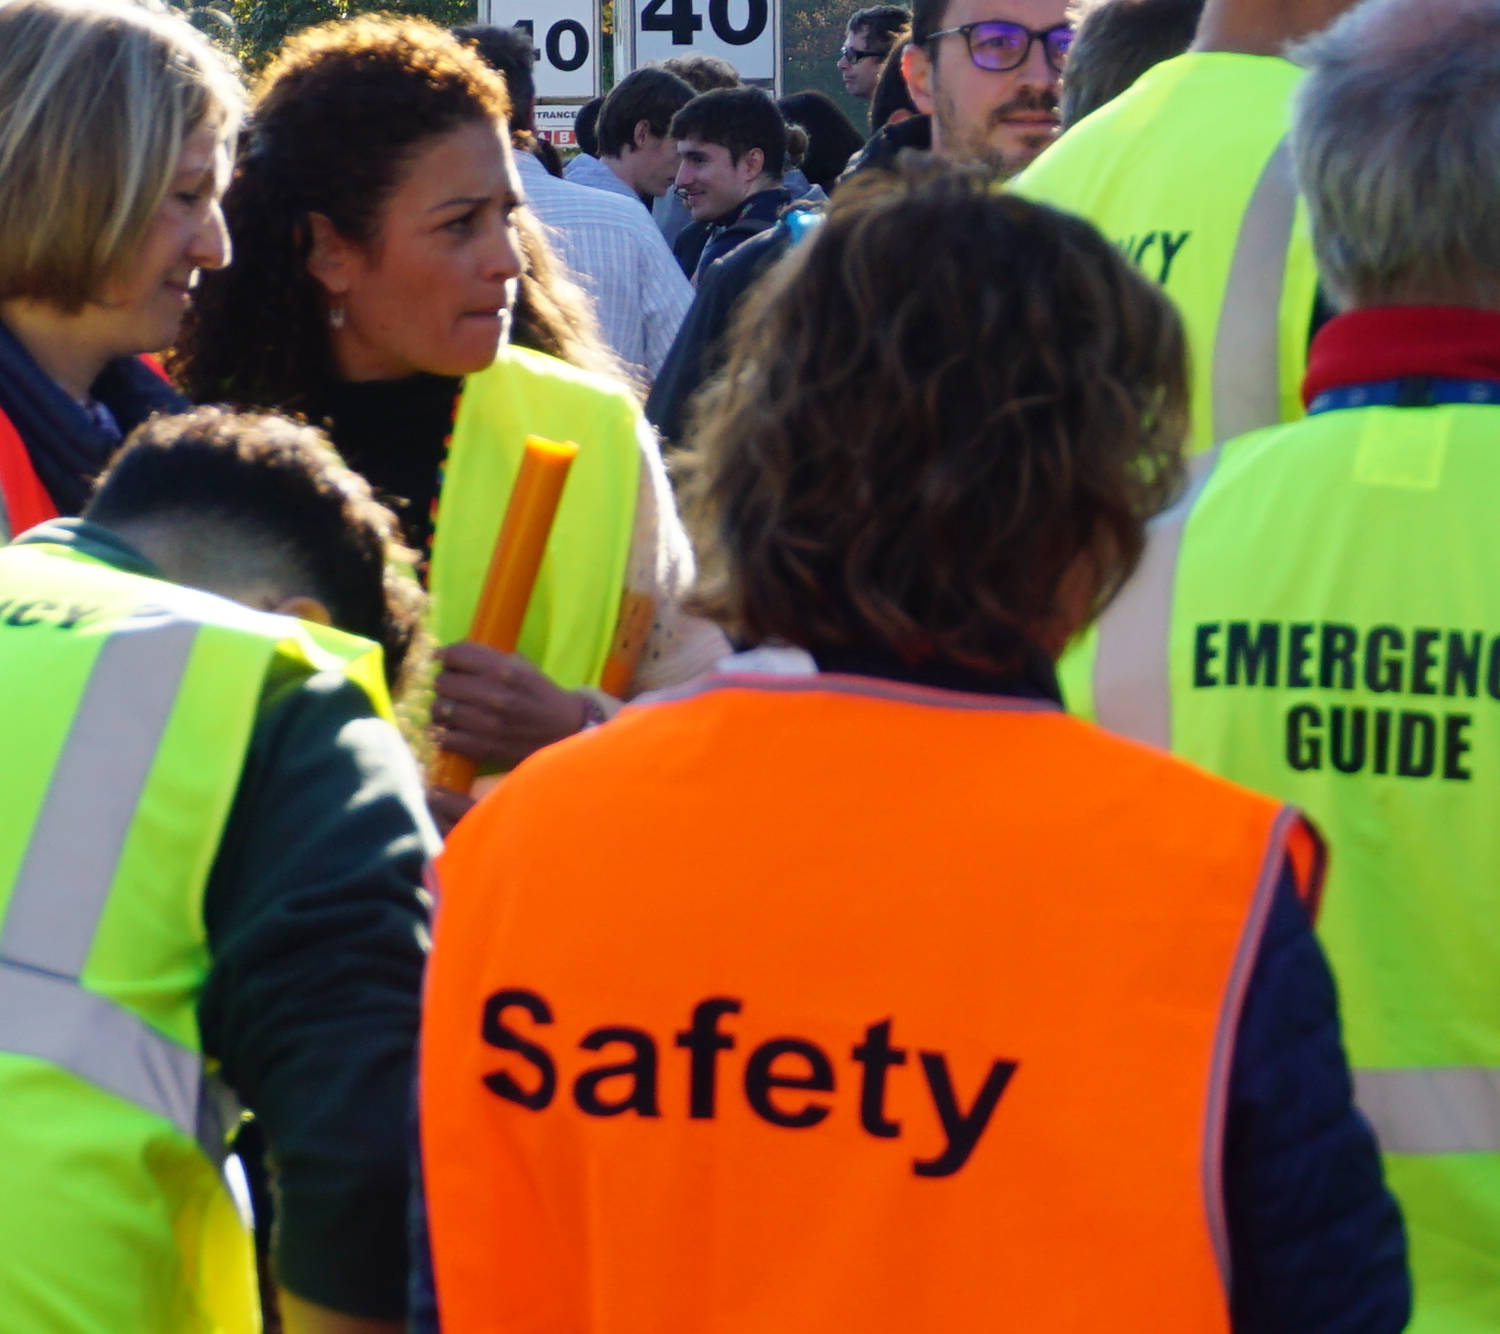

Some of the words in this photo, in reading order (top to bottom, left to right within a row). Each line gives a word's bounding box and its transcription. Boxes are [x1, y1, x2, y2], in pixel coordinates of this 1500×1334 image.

[512, 18, 590, 72] 0
[560, 132, 570, 143] B
[1285, 703, 1472, 781] GUIDE
[481, 987, 1020, 1179] Safety
